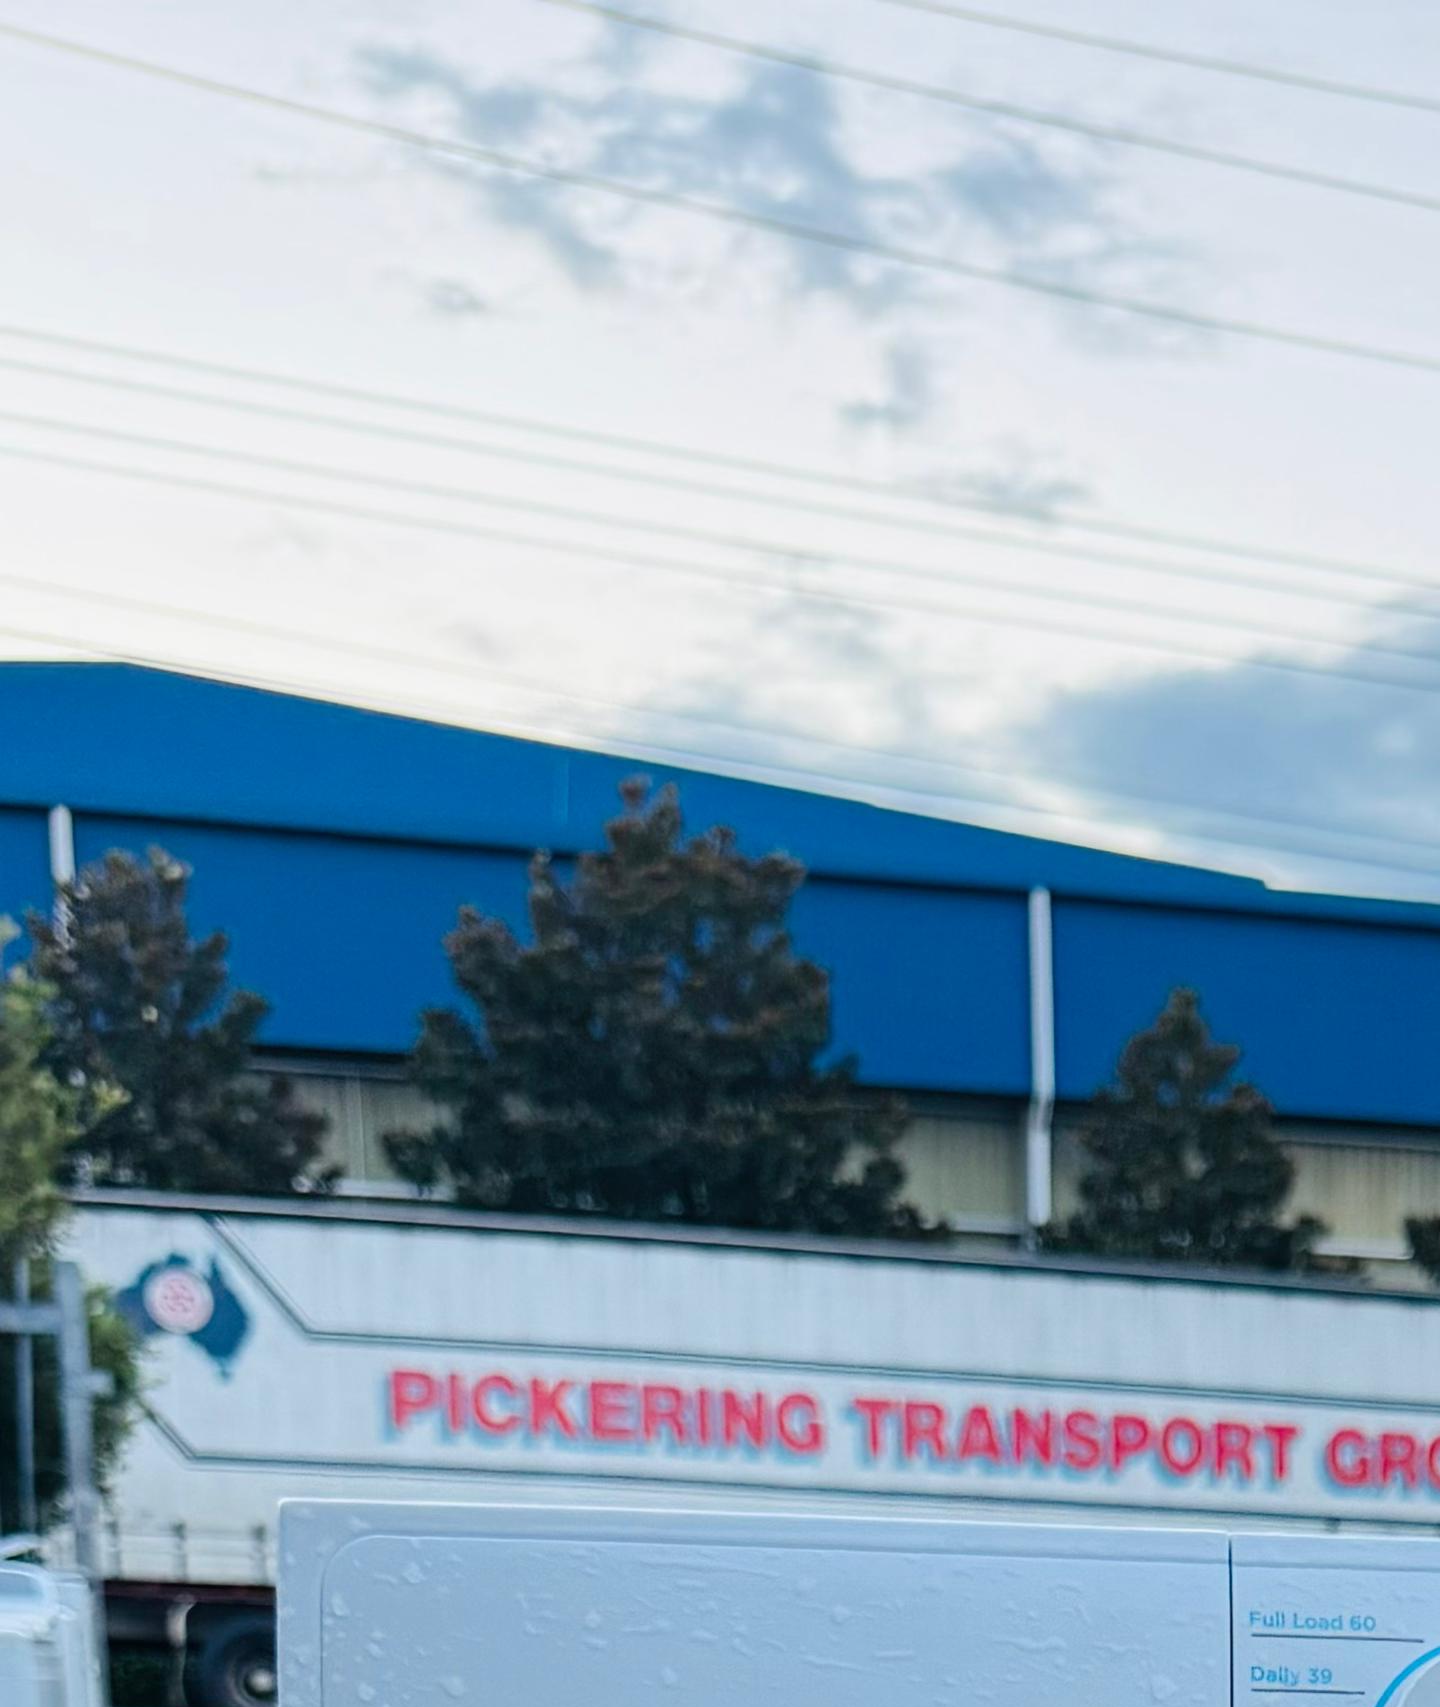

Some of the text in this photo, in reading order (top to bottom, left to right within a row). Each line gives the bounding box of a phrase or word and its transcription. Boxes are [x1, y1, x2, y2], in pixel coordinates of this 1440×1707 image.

[387, 1368, 827, 1455] PICKERING
[854, 1396, 1299, 1482] TRANSPORT
[1249, 1611, 1377, 1631] Full Load 60
[1250, 1665, 1333, 1687] Daily 39
